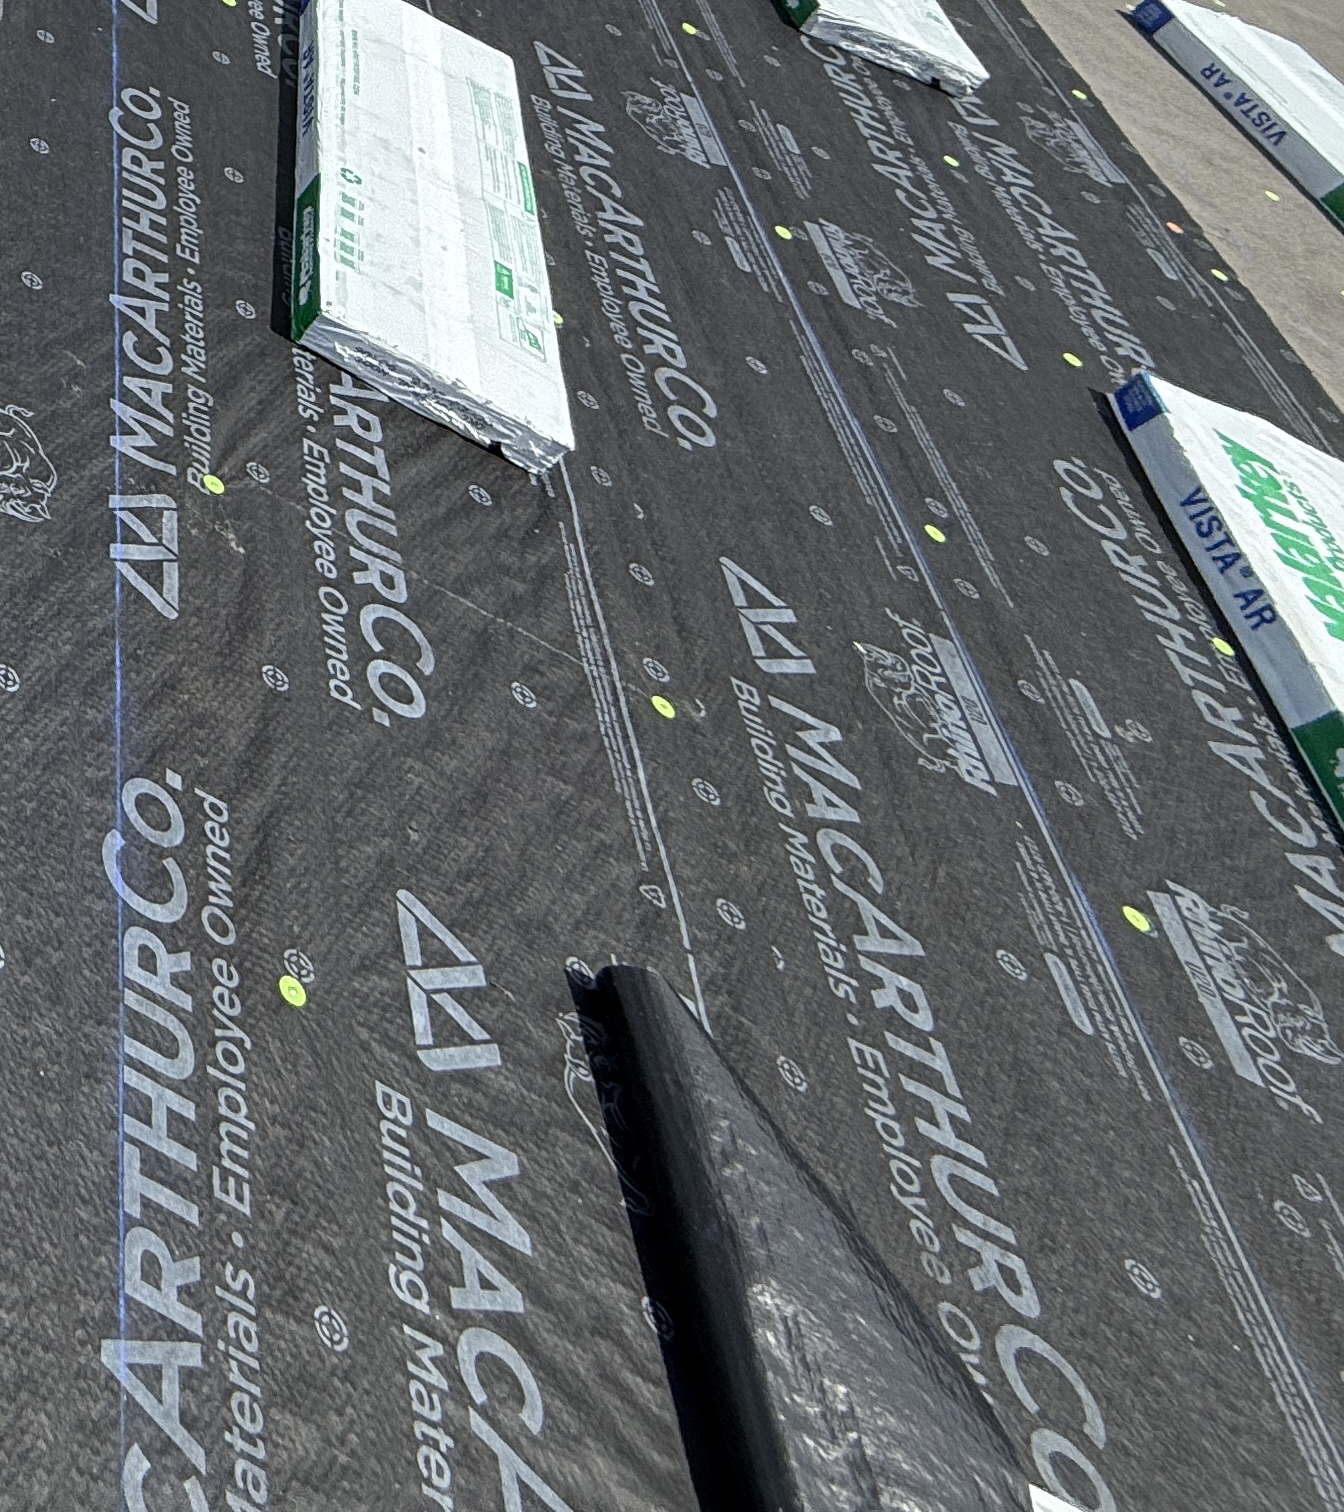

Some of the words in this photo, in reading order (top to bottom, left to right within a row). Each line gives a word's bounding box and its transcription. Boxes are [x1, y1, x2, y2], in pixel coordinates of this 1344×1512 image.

[169, 97, 192, 167] Owned
[1198, 61, 1231, 92] AR
[109, 85, 175, 476] MACARTHURCO.
[172, 166, 204, 270] Employee
[530, 93, 566, 162] Building
[551, 158, 593, 242] Materials
[583, 248, 634, 360] Employee
[620, 352, 669, 439] Owned
[557, 105, 718, 452] MACARTHURCO.
[178, 274, 209, 386] Materials
[186, 386, 216, 495] Building
[299, 435, 338, 581] Employee
[317, 584, 363, 712] Owned
[1232, 575, 1280, 634] AR
[197, 787, 234, 949] Owned
[729, 675, 797, 835] Building
[784, 826, 859, 1005] Materials
[843, 1034, 954, 1288] Employee
[1165, 878, 1322, 1125] RhinoRoof
[200, 949, 255, 1220] Employee
[375, 1080, 434, 1322] Building
